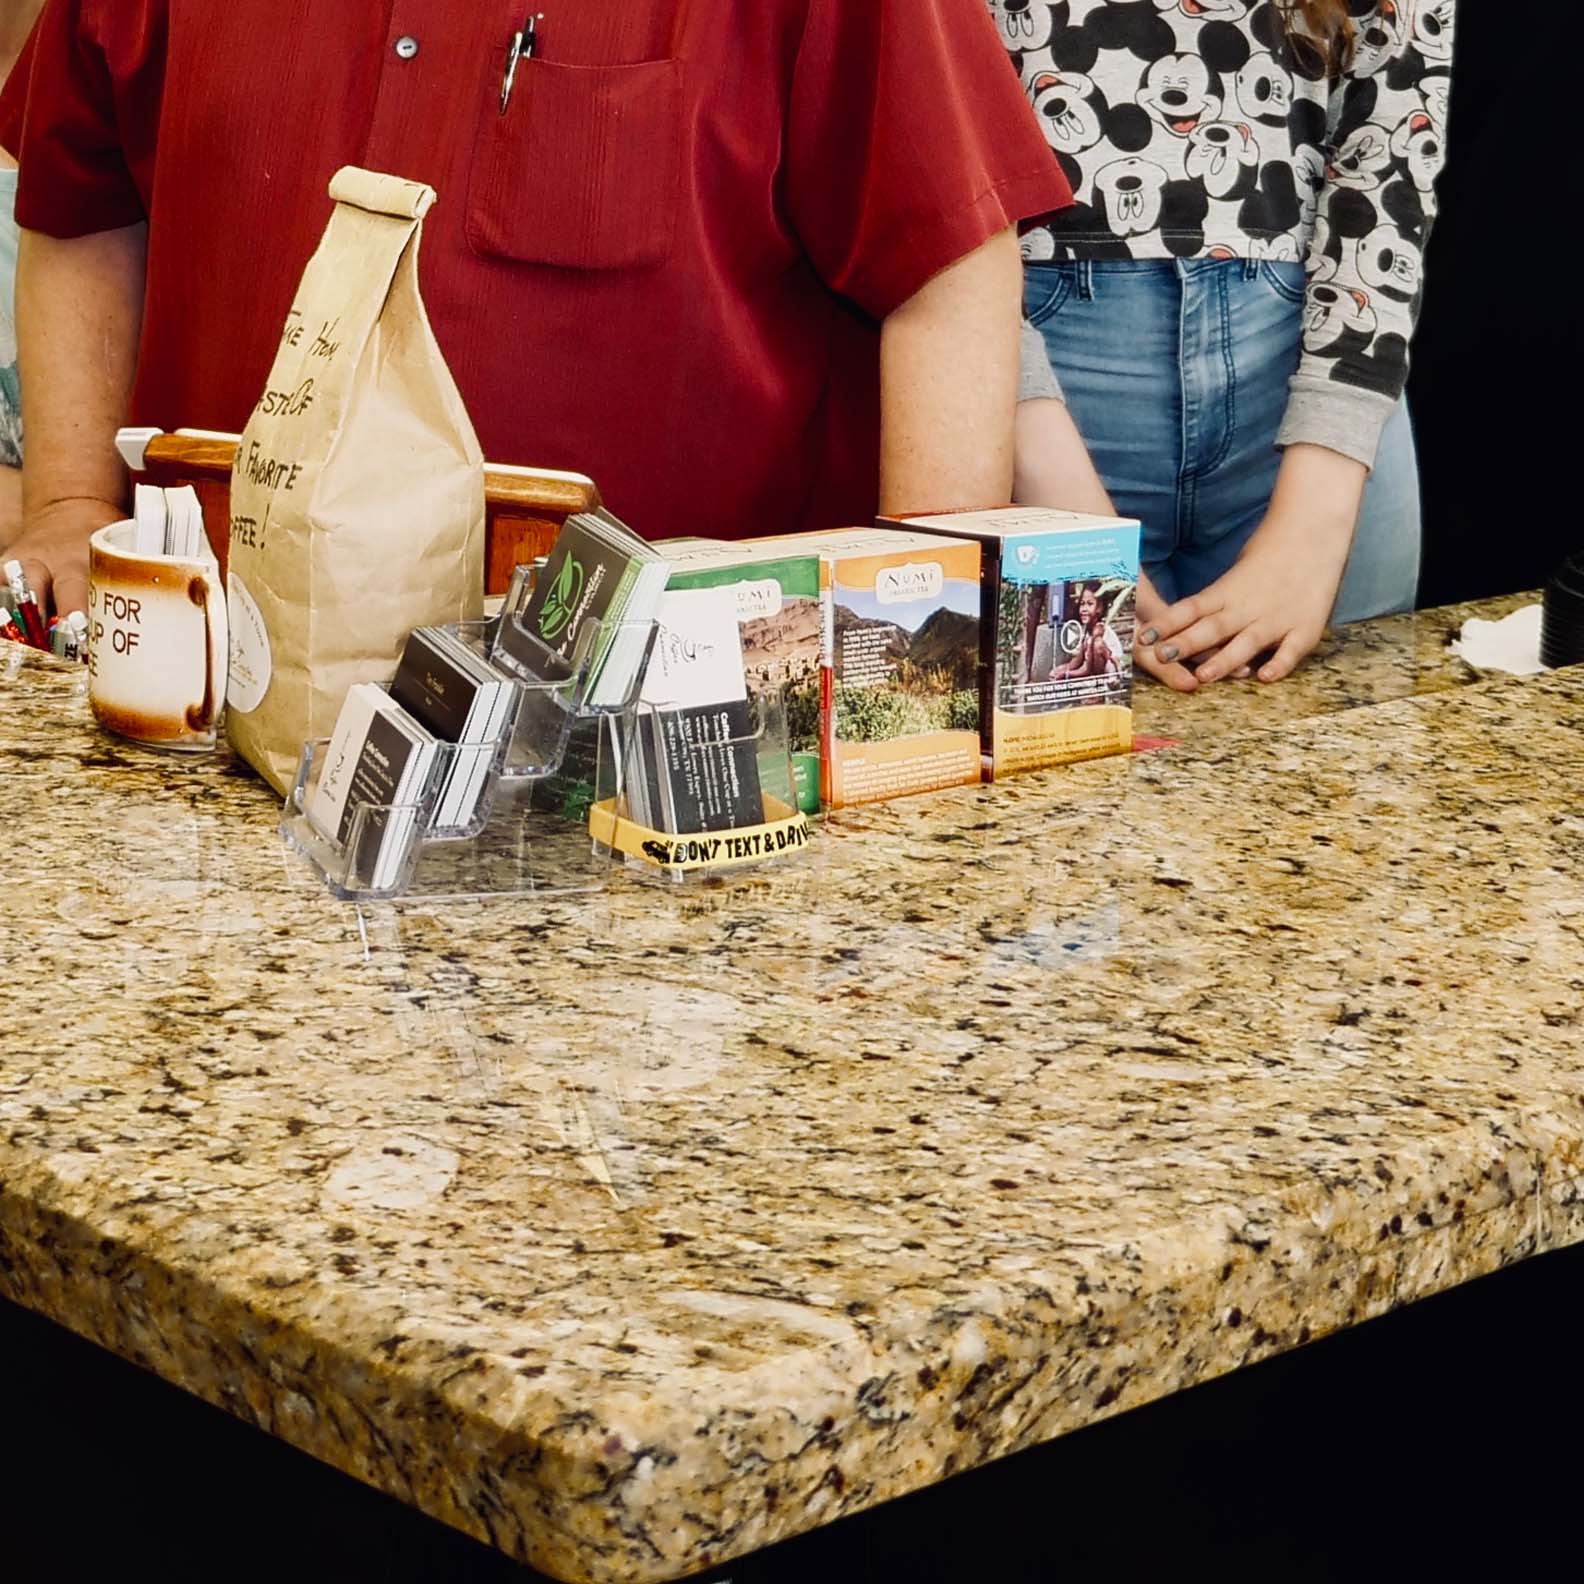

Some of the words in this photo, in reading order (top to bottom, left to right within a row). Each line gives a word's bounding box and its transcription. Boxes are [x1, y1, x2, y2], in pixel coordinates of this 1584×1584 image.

[104, 592, 142, 624] FOR
[113, 629, 140, 655] OF
[725, 834, 761, 858] TEXT
[764, 833, 775, 853] &
